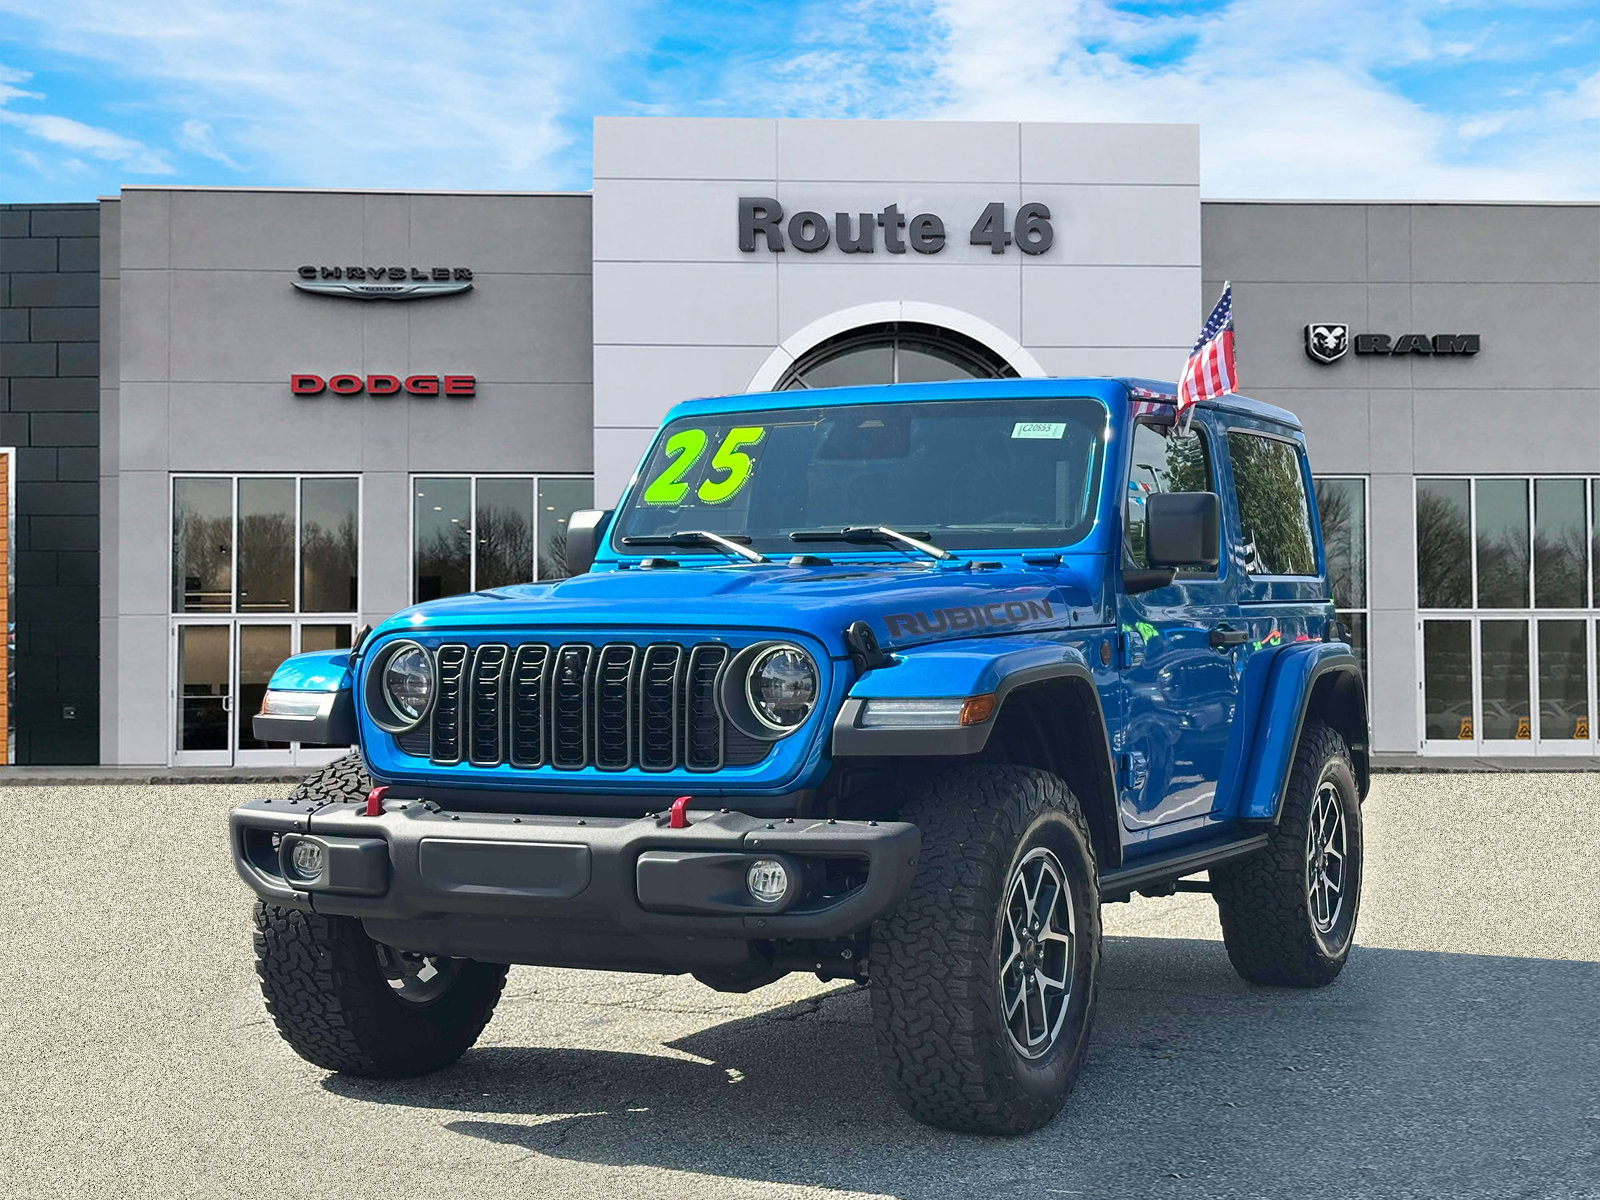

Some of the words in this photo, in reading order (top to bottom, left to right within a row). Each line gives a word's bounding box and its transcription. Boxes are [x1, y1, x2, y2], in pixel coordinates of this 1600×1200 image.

[738, 197, 946, 255] Route
[969, 202, 1054, 256] 46
[297, 266, 474, 280] CHRYSLER
[1354, 334, 1481, 355] RAM
[291, 374, 476, 396] DODGE
[644, 428, 767, 505] 25
[882, 598, 1054, 639] RUBICON
